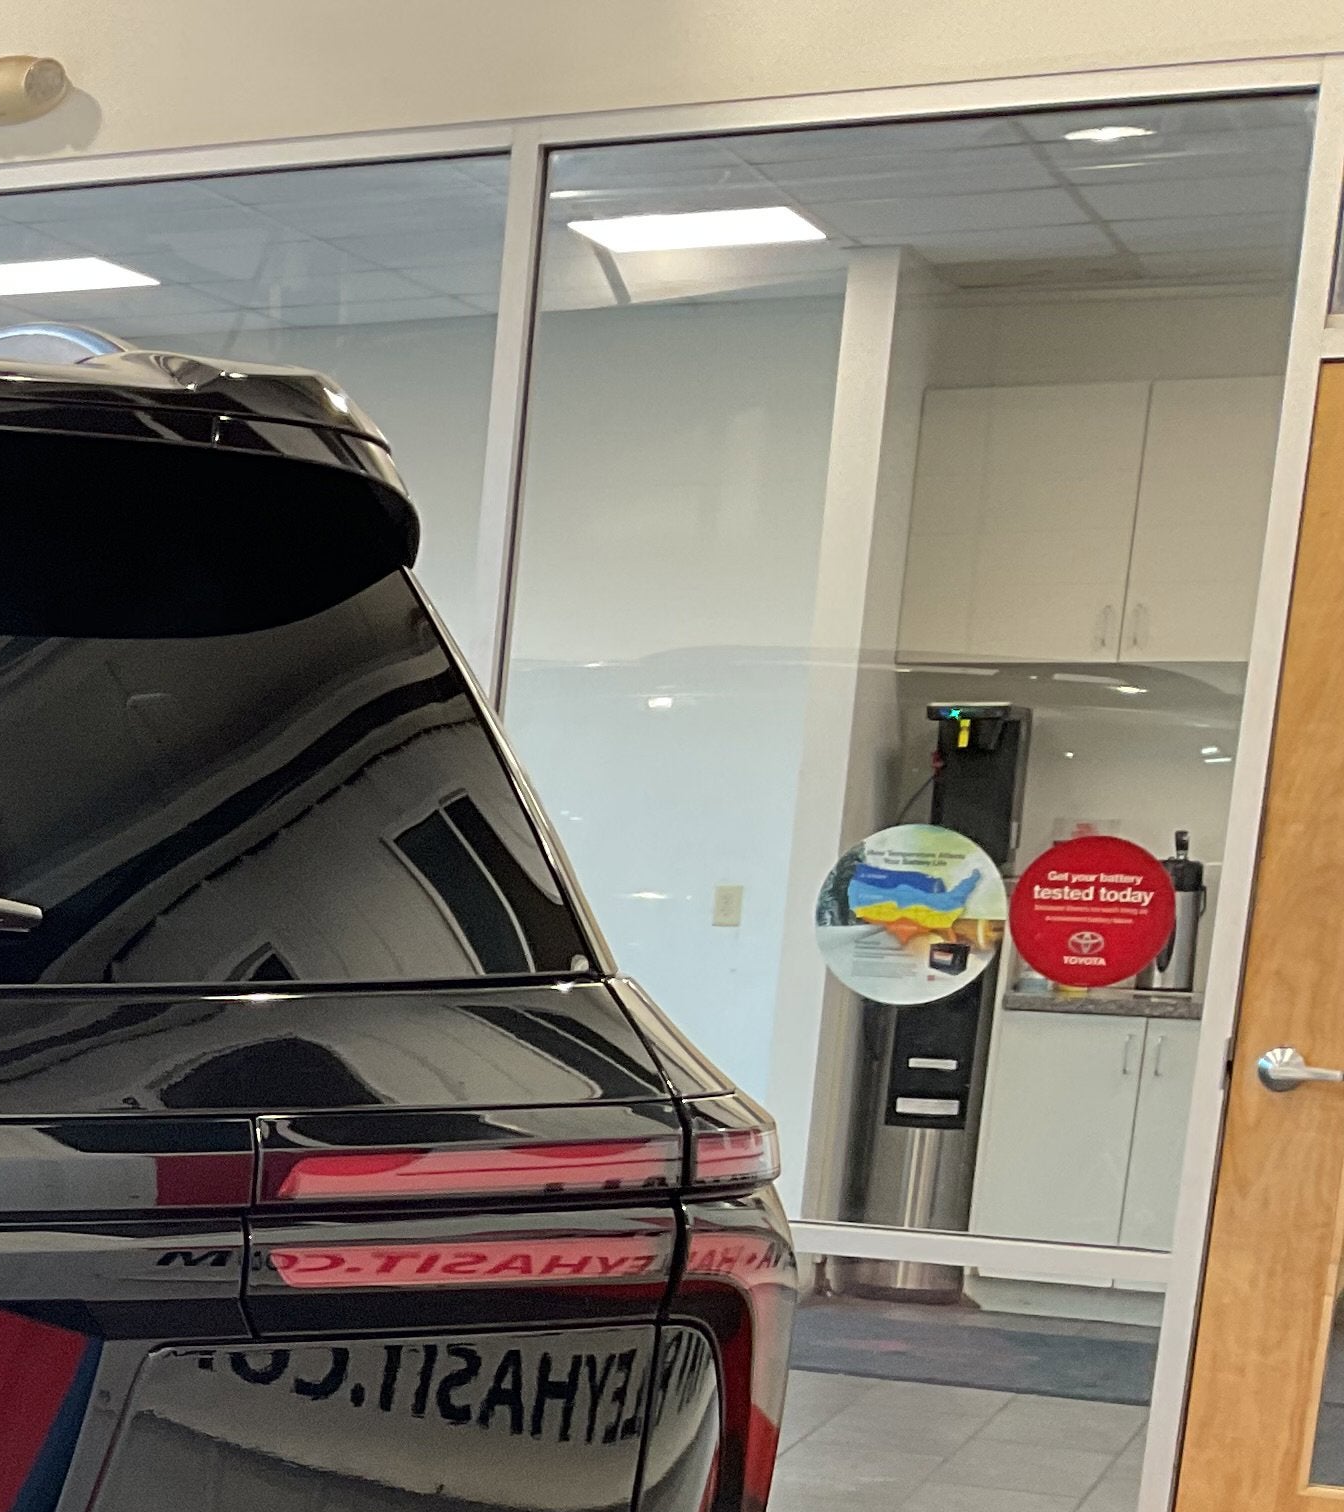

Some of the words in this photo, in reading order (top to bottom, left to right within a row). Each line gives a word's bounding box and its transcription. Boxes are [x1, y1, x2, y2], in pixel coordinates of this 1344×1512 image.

[1047, 870, 1069, 882] Get
[1070, 873, 1099, 884] your
[1099, 872, 1144, 886] battery
[1033, 884, 1095, 901] tested
[1099, 886, 1155, 906] today
[1063, 955, 1107, 967] TOYOTA
